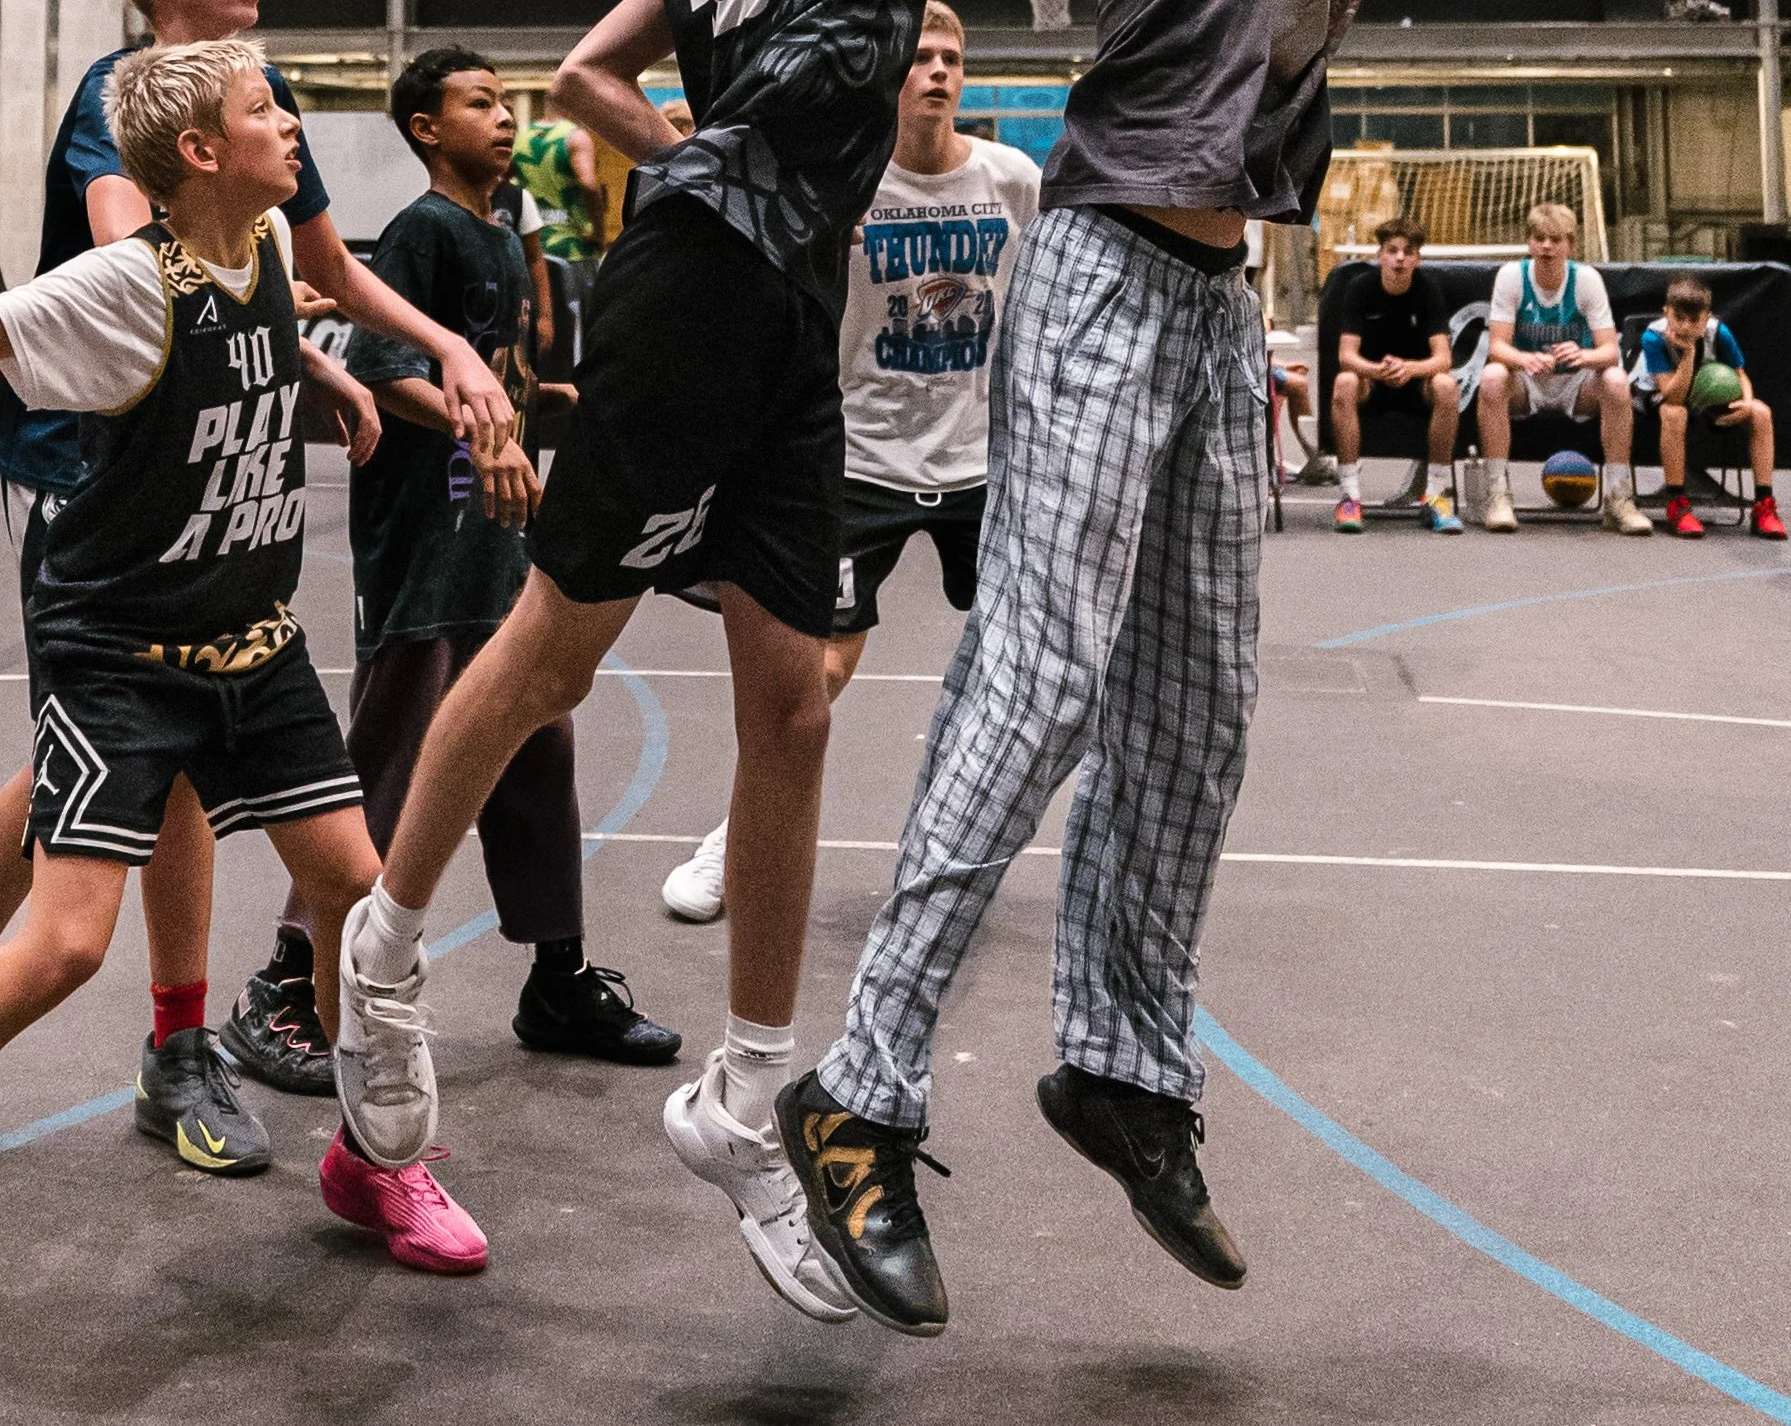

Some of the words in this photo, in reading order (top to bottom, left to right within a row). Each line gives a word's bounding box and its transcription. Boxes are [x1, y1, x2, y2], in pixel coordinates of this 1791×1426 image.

[870, 204, 968, 221] OKLAHOMA
[226, 326, 274, 391] 40
[188, 381, 299, 464] PLAY
[200, 439, 292, 511] LIKE
[159, 513, 212, 563] A
[216, 486, 305, 556] PRO
